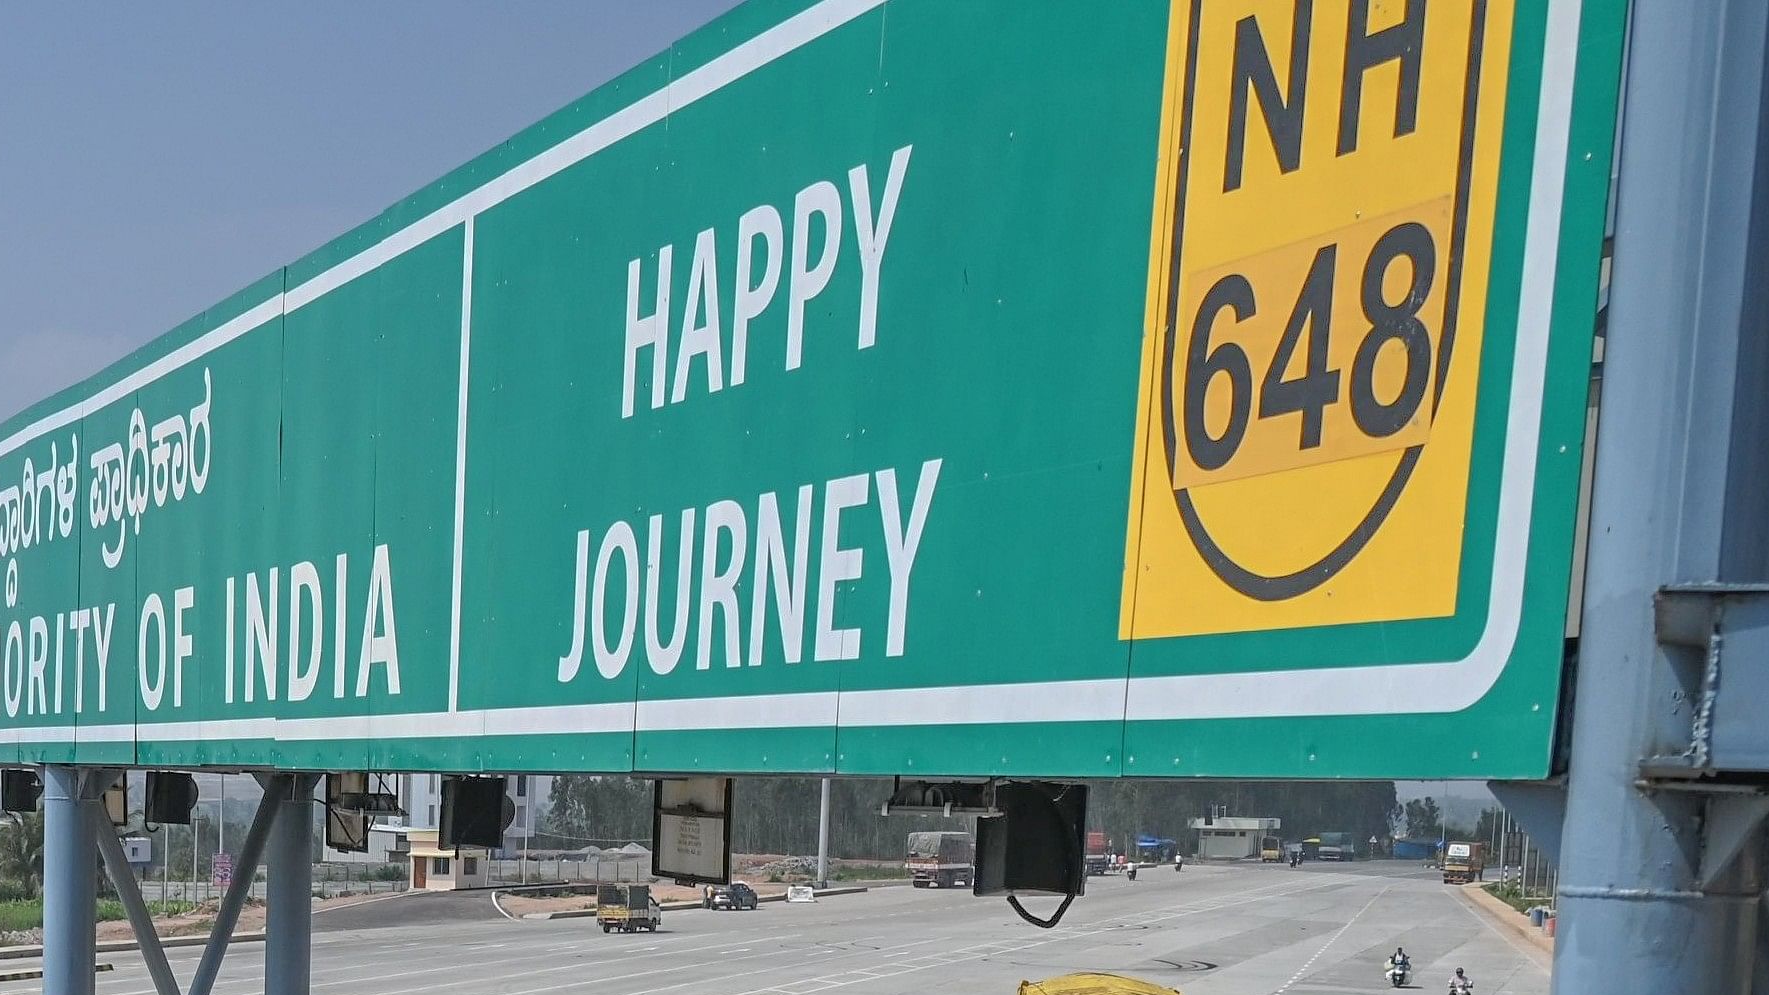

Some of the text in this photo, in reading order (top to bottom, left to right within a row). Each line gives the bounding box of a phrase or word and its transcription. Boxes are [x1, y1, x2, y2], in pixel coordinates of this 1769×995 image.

[1221, 0, 1426, 194] NH
[621, 143, 914, 420] HAPPY
[1182, 221, 1437, 472] 648
[89, 366, 212, 570] ಪ್ರಾಧಿಕಾರ
[557, 457, 943, 683] JOURNEY
[138, 587, 194, 711] OF
[226, 543, 401, 704] INDIA
